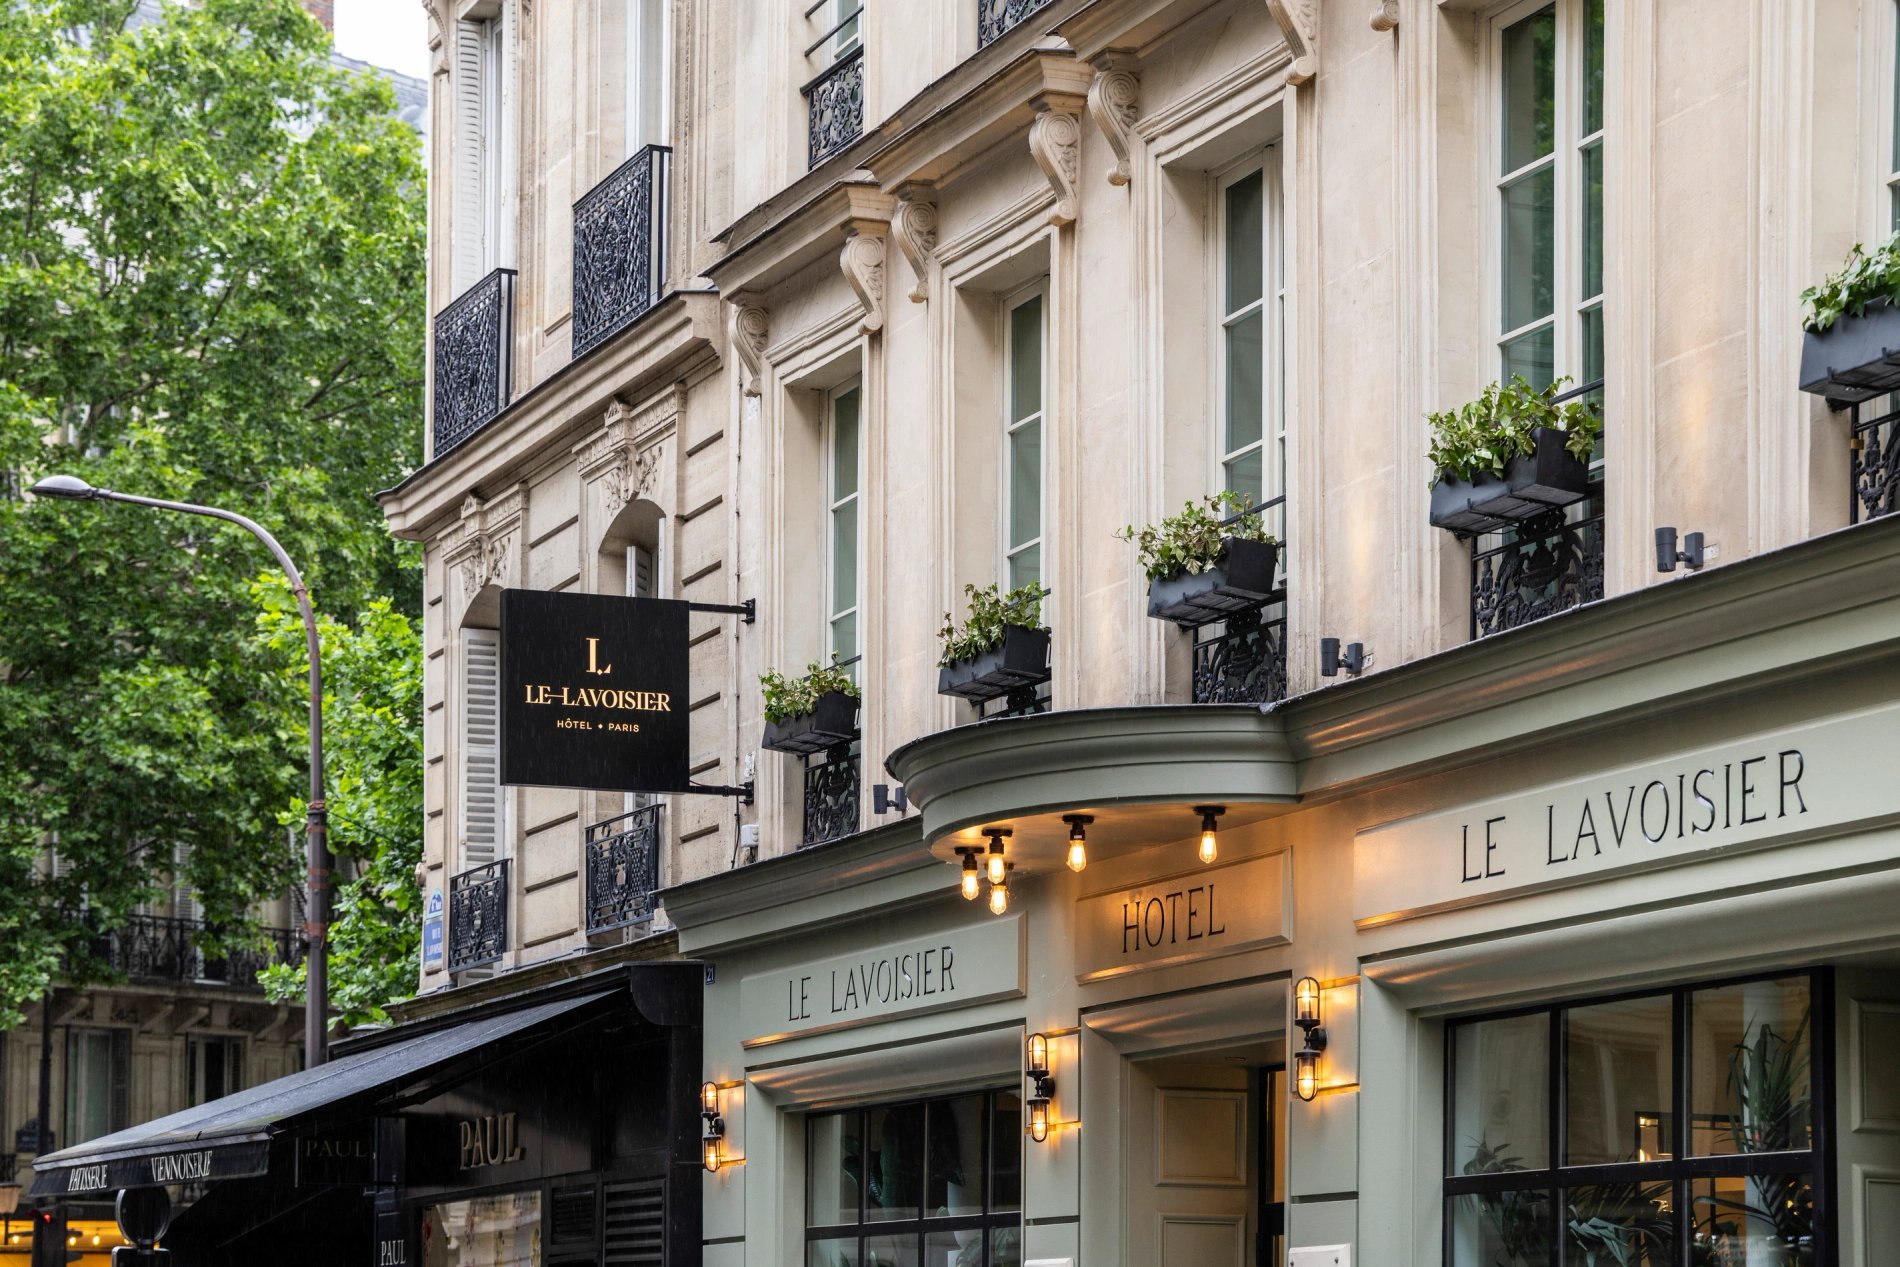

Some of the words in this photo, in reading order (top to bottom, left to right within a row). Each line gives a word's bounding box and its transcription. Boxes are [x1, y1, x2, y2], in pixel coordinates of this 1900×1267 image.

[586, 637, 612, 675] L
[525, 685, 551, 704] LE
[561, 686, 671, 711] LAVOISIER
[556, 718, 592, 730] HÔTEL
[608, 722, 640, 733] PARIS
[1461, 816, 1506, 883] LE
[1546, 749, 1808, 866] LAVOISIER
[1122, 884, 1225, 954] HOTEL
[788, 976, 812, 1022] LE
[830, 946, 955, 1014] LAVOISIER
[306, 1140, 368, 1158] PAUL
[459, 1112, 522, 1170] PAUL
[151, 1151, 213, 1182] VIENNOISERIE
[380, 1240, 407, 1266] PAUL
